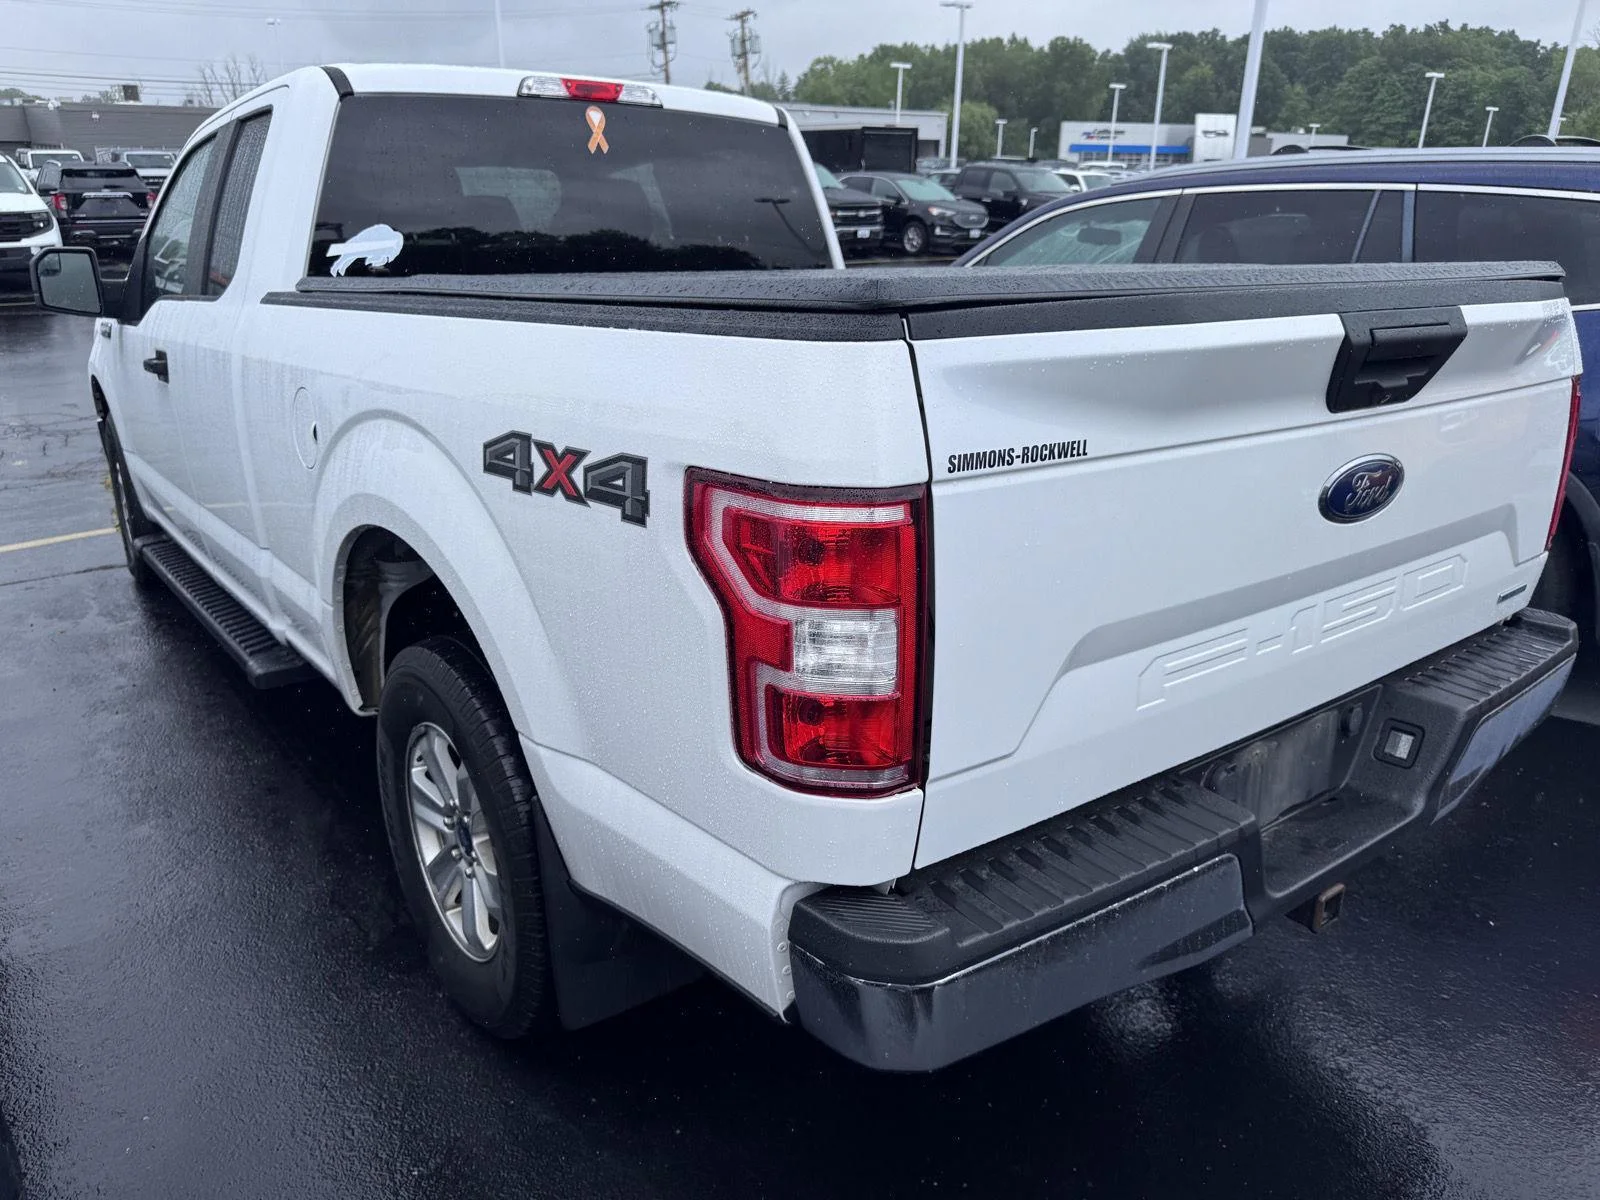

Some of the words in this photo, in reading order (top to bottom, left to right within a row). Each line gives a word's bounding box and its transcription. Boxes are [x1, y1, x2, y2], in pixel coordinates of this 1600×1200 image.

[947, 439, 1088, 474] SIMMONS-ROCKWELL
[1343, 469, 1392, 515] Ford
[1136, 553, 1468, 712] F-150
